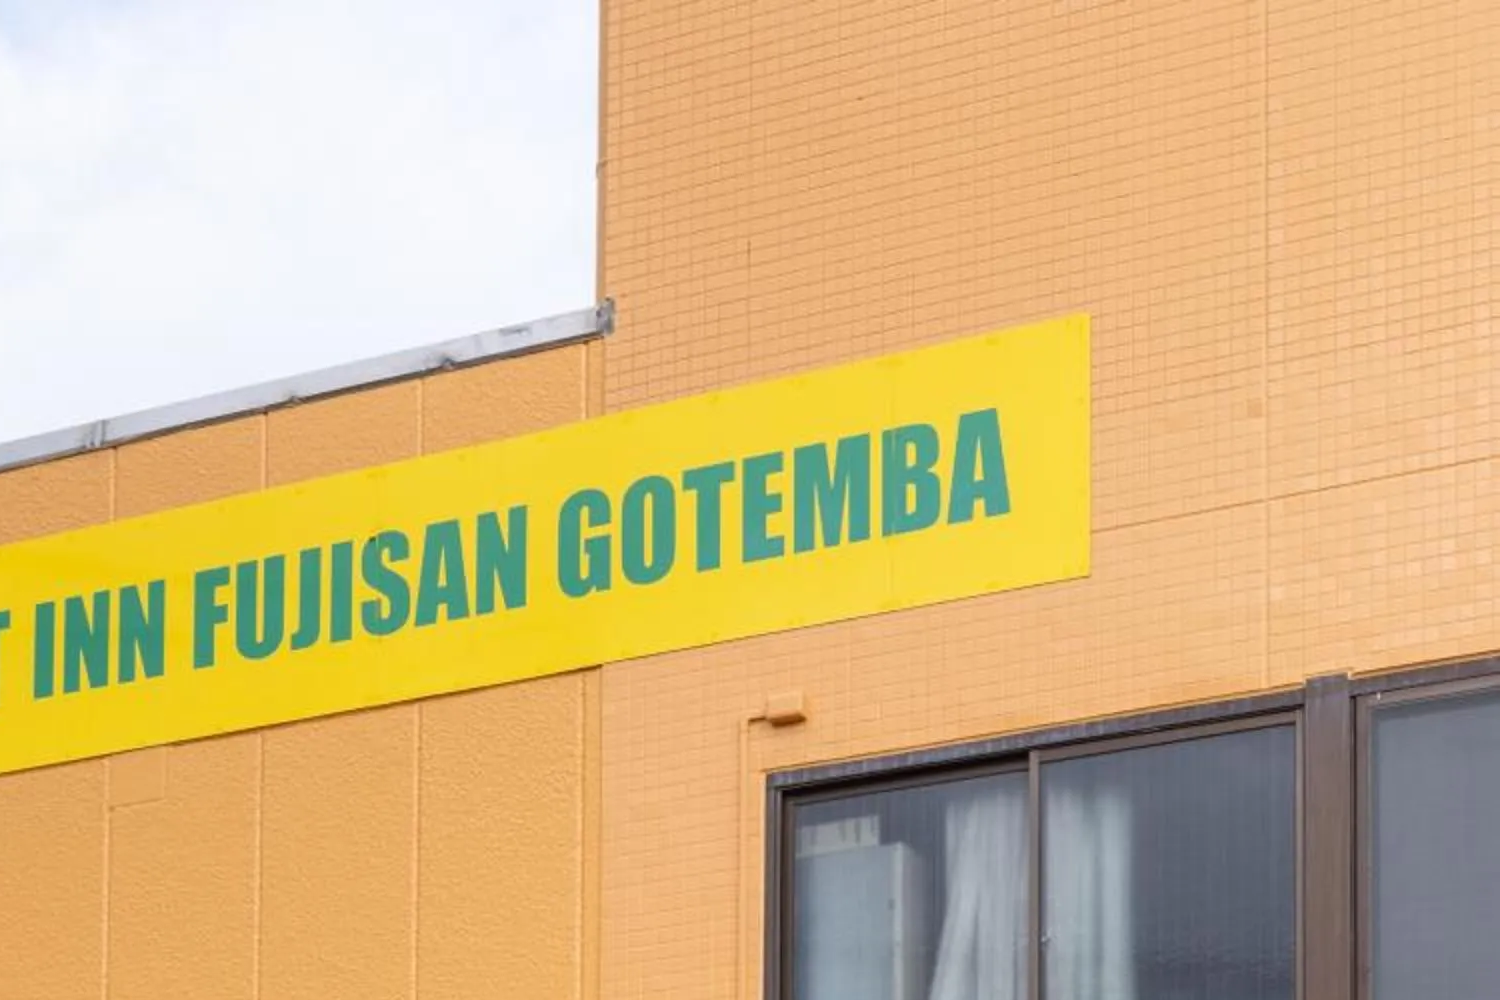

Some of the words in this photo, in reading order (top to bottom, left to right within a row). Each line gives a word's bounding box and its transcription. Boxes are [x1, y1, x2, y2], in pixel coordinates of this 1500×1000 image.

[33, 579, 167, 699] INN
[192, 506, 528, 669] FUJISAN
[557, 407, 1011, 600] GOTEMBA
